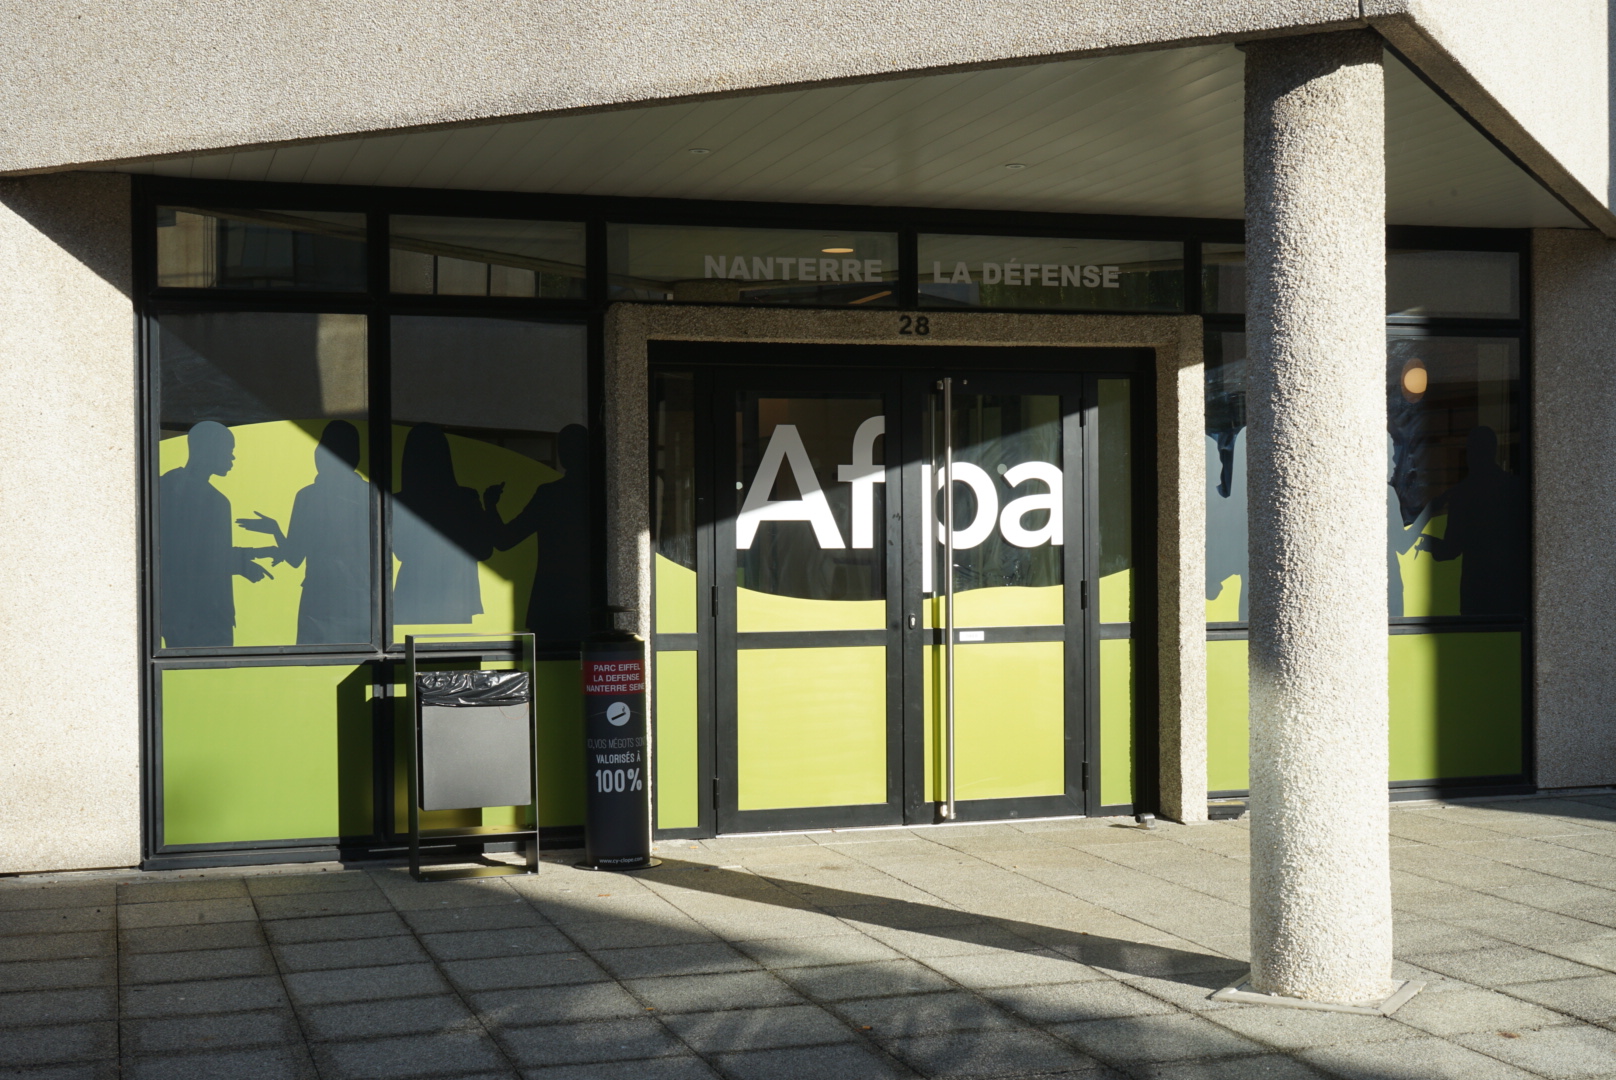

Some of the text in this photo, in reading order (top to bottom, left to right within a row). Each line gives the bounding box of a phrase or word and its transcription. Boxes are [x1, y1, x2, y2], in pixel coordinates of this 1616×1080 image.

[703, 255, 1120, 289] NANTERRE LA DÉFENSE
[900, 316, 930, 336] 28
[736, 415, 1064, 593] Afpa
[618, 663, 641, 671] EIFFEL
[606, 673, 639, 682] DEFENSE
[586, 684, 627, 692] NANTERRE
[608, 737, 634, 749] MÉGOTS
[596, 750, 641, 764] VALORISÉS À
[595, 768, 642, 793] 100%
